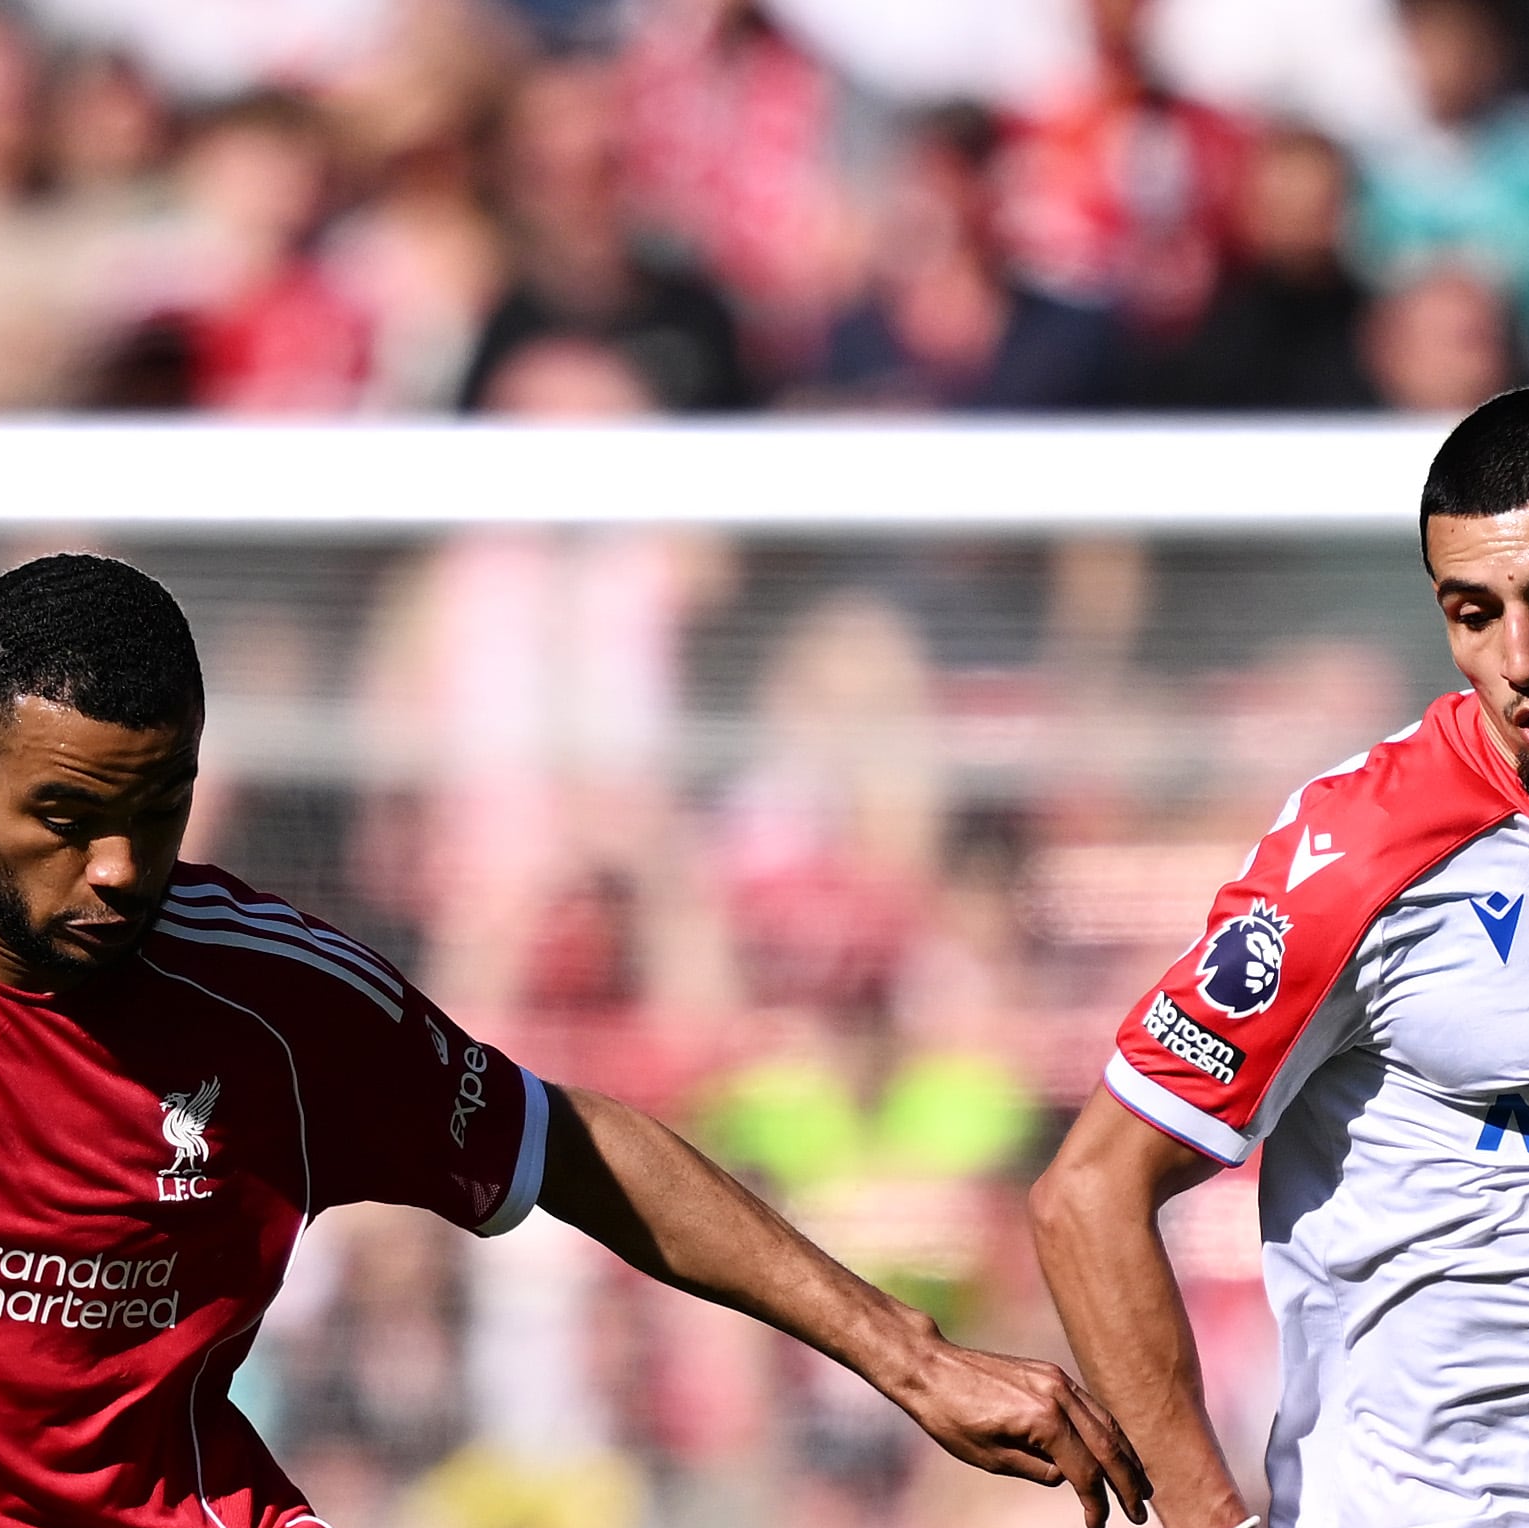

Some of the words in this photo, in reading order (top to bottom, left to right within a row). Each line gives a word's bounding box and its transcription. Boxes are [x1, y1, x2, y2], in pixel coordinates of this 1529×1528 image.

[1152, 990, 1178, 1024] No
[1175, 1017, 1235, 1065] room
[1163, 1032, 1235, 1085] racism
[450, 1040, 488, 1149] Expe
[156, 1176, 212, 1202] L.F.C.
